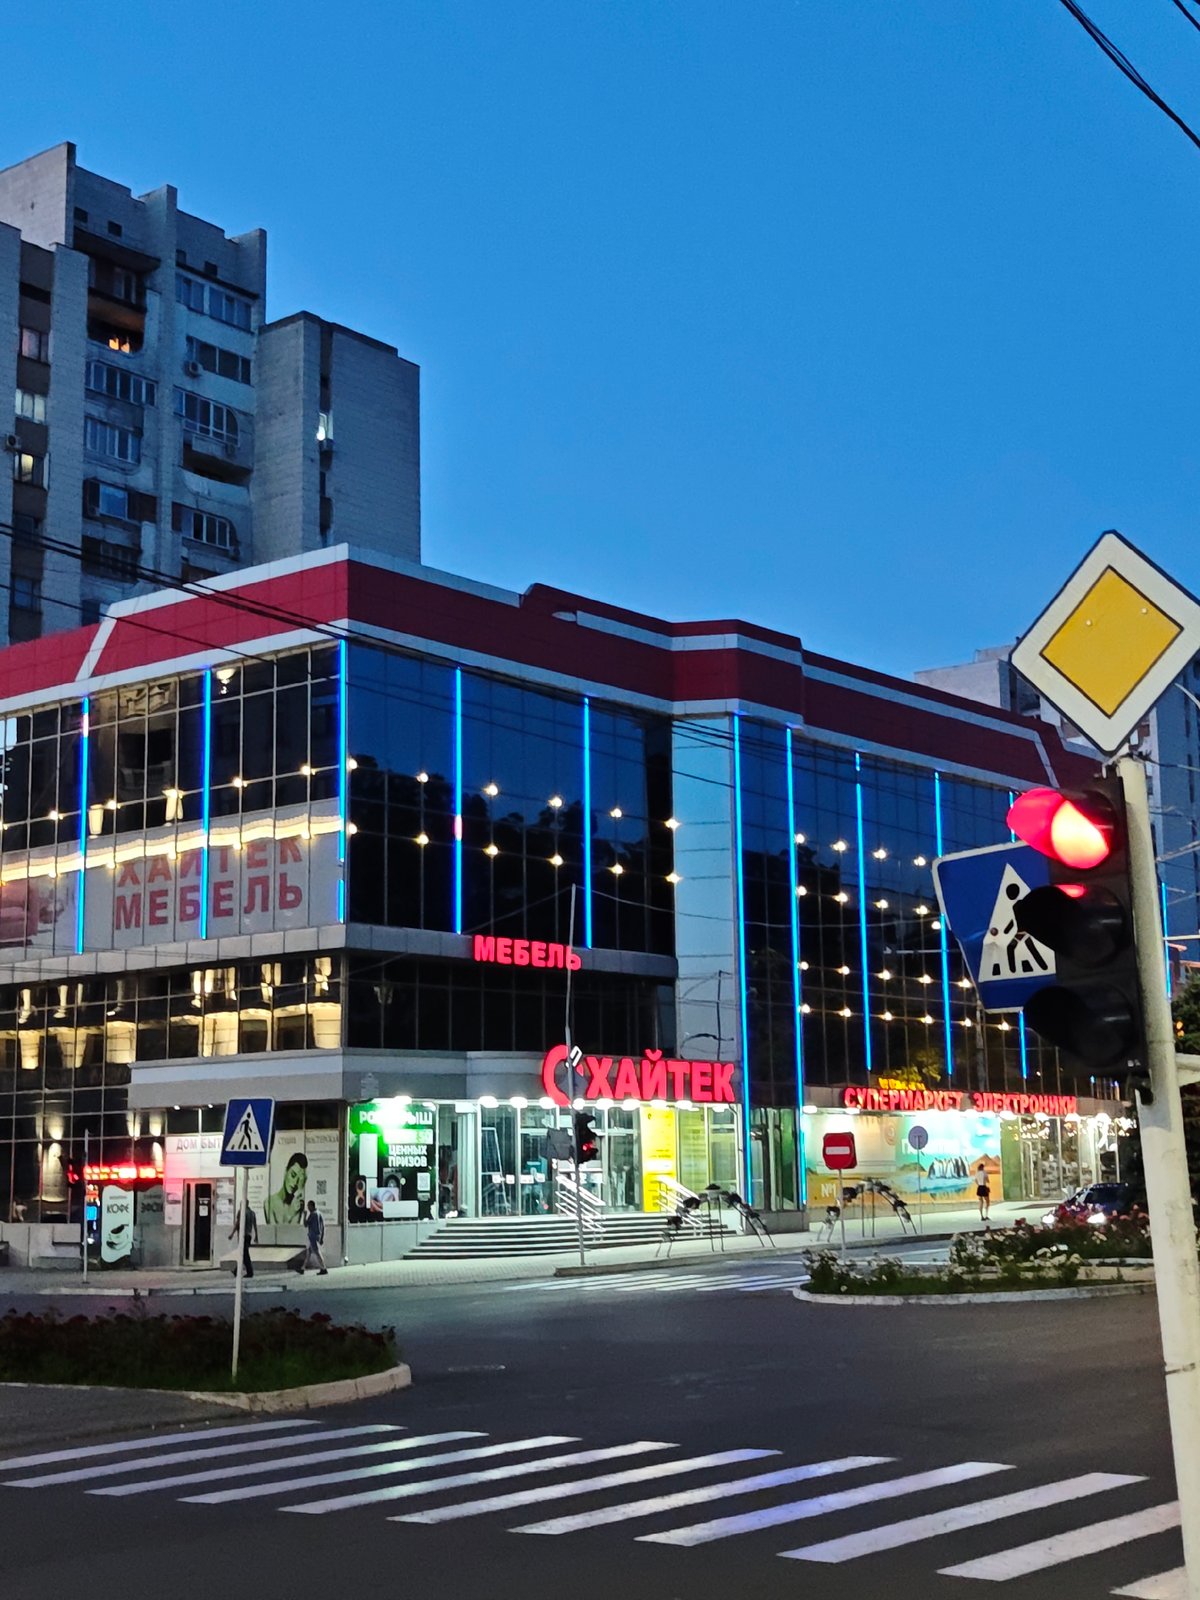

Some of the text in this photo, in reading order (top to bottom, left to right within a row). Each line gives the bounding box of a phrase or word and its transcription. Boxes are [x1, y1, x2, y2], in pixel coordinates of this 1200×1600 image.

[115, 872, 303, 931] МЕБЕЛЬ
[474, 934, 582, 971] МЕБЕЛЬ
[585, 1048, 736, 1103] ХАЙТЕК
[844, 1087, 1078, 1115] СУПЕРМАРКЕТ ЭЛЕКТРОНИКИ
[176, 1137, 223, 1151] ДОМ БЫТ
[388, 1145, 428, 1157] ЦЕННЫХ
[388, 1156, 428, 1168] ПРИЗОВ
[106, 1203, 130, 1214] КОФЕ
